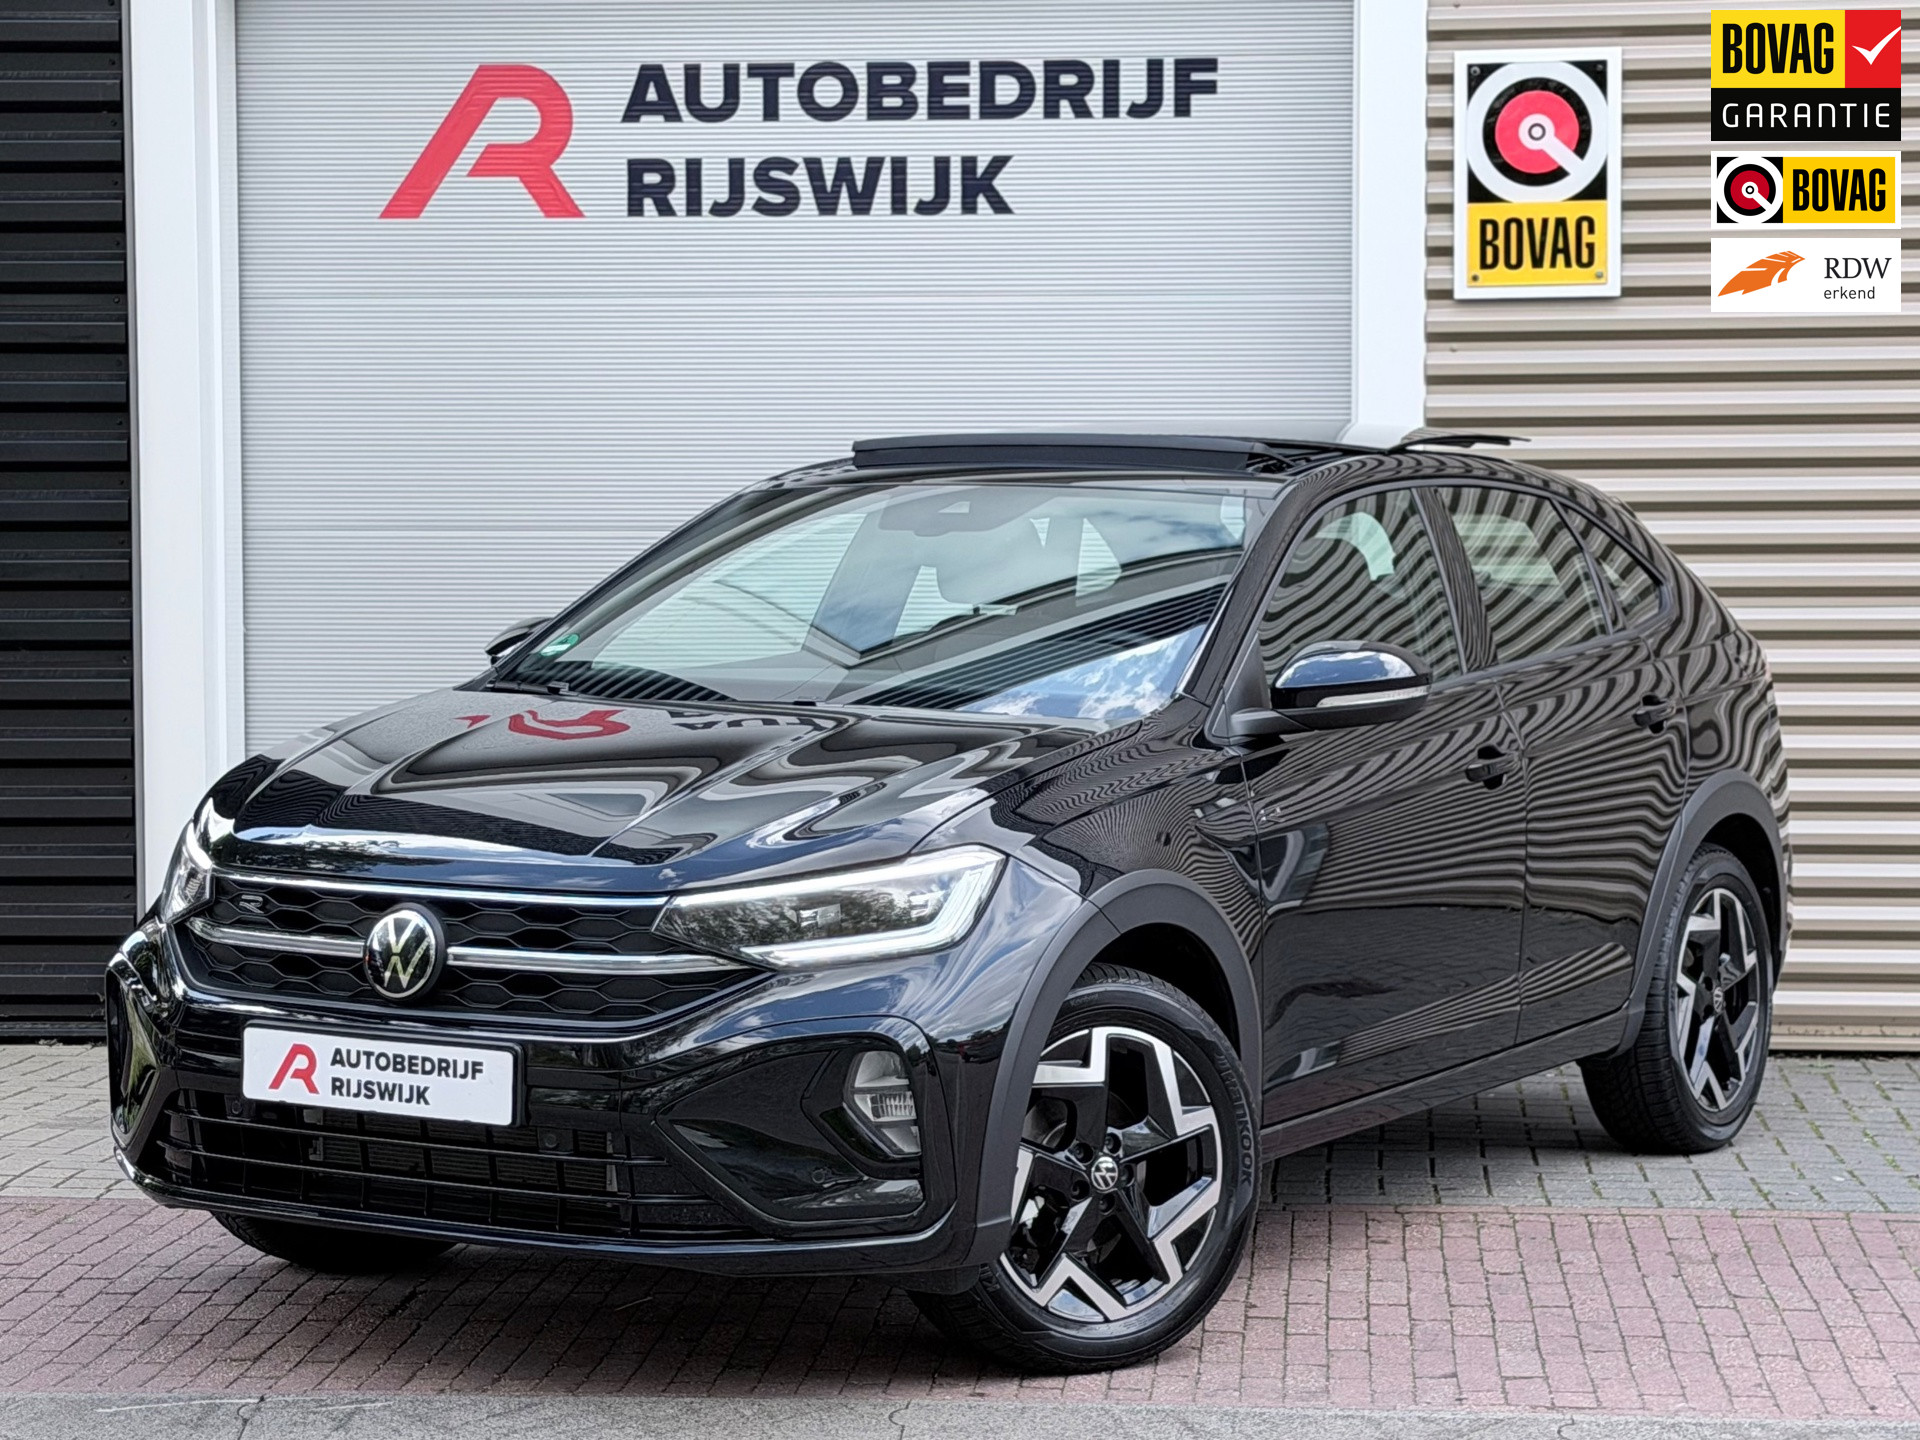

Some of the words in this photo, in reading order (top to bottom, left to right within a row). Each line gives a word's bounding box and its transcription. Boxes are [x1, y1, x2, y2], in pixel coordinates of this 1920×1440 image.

[621, 57, 1219, 124] AUTOBEDRIJF
[626, 155, 1015, 218] RIJSWIJK
[1479, 215, 1596, 271] BOVAG
[330, 1047, 484, 1080] AUTOBEDRIJF
[330, 1076, 431, 1106] RIJSWIJK
